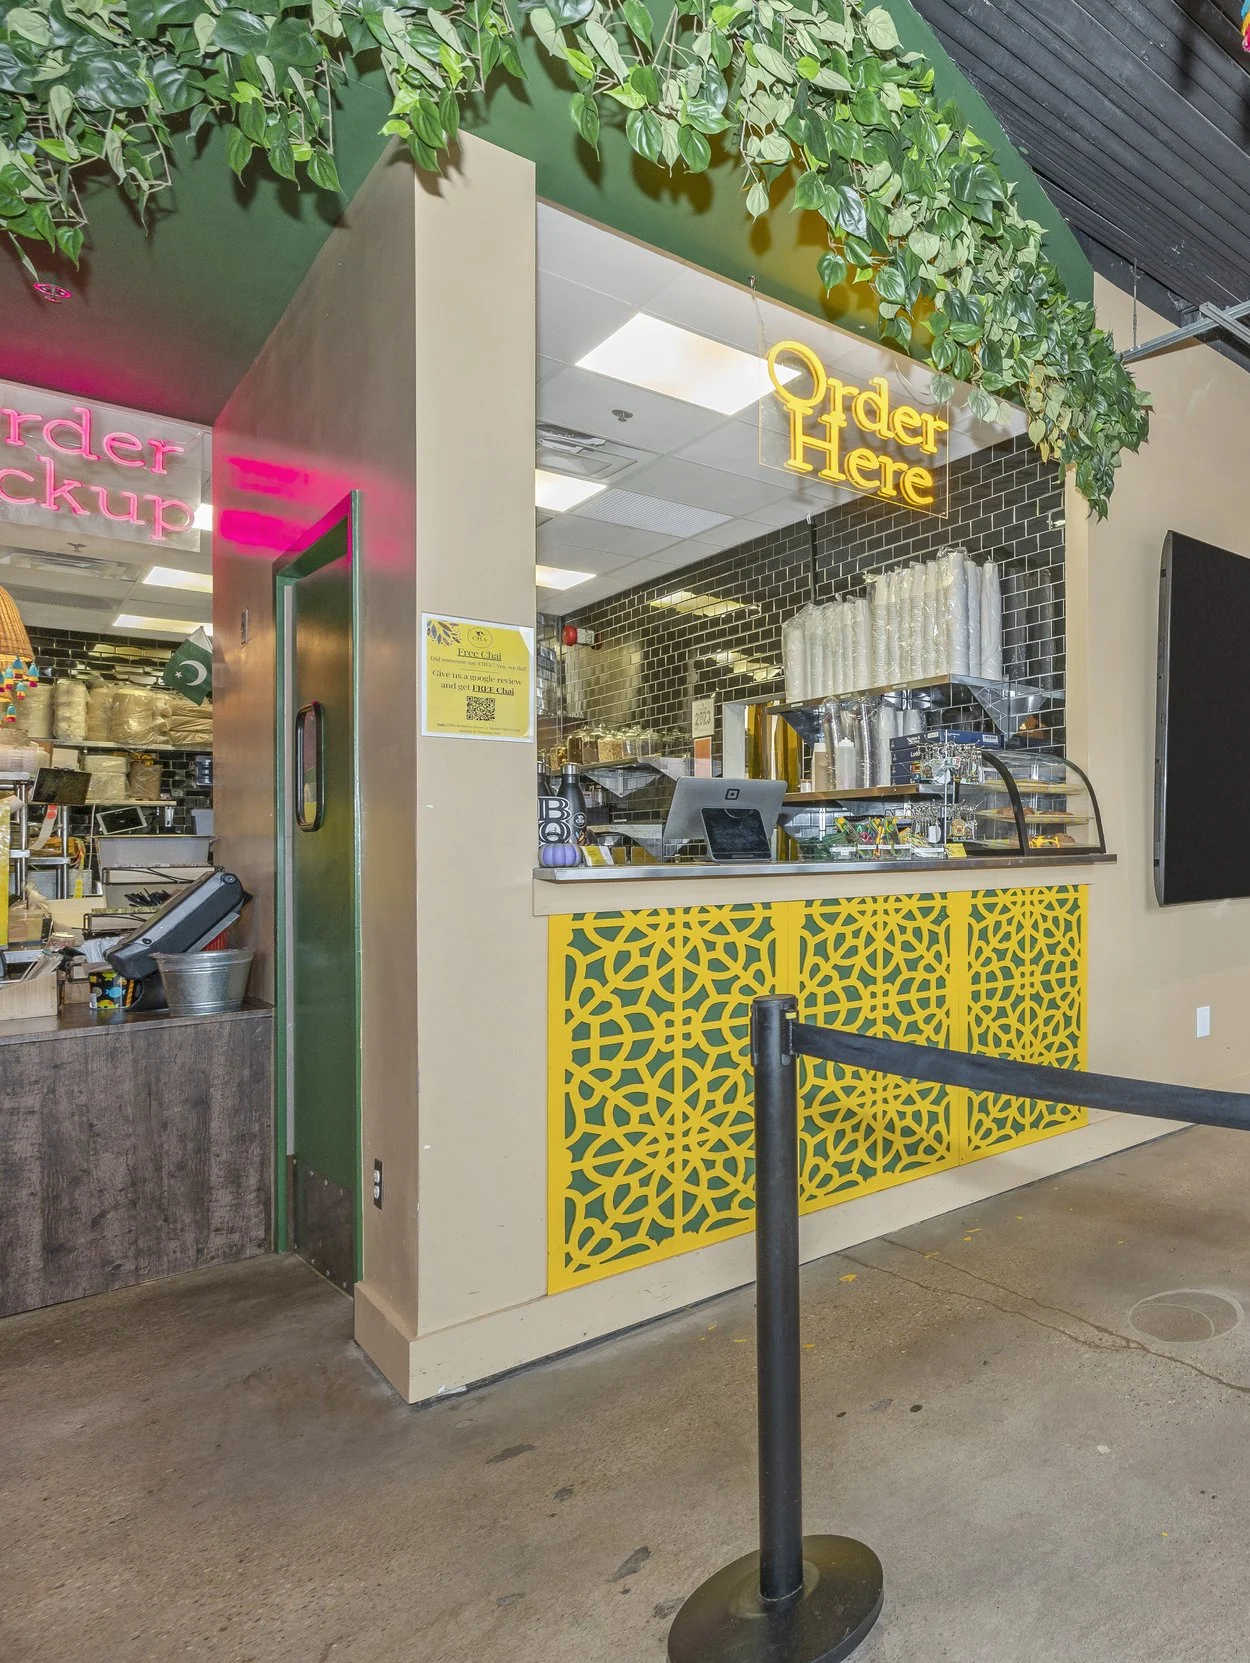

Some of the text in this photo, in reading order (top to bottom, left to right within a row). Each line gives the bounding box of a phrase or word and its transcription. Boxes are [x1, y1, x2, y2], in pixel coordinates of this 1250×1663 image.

[767, 340, 949, 455] Order
[784, 401, 934, 506] Here
[458, 647, 502, 661] Free Chai
[432, 669, 451, 678] Give
[469, 675, 496, 684] google
[497, 677, 523, 685] review
[472, 685, 495, 693] FREE
[496, 687, 515, 696] Chai
